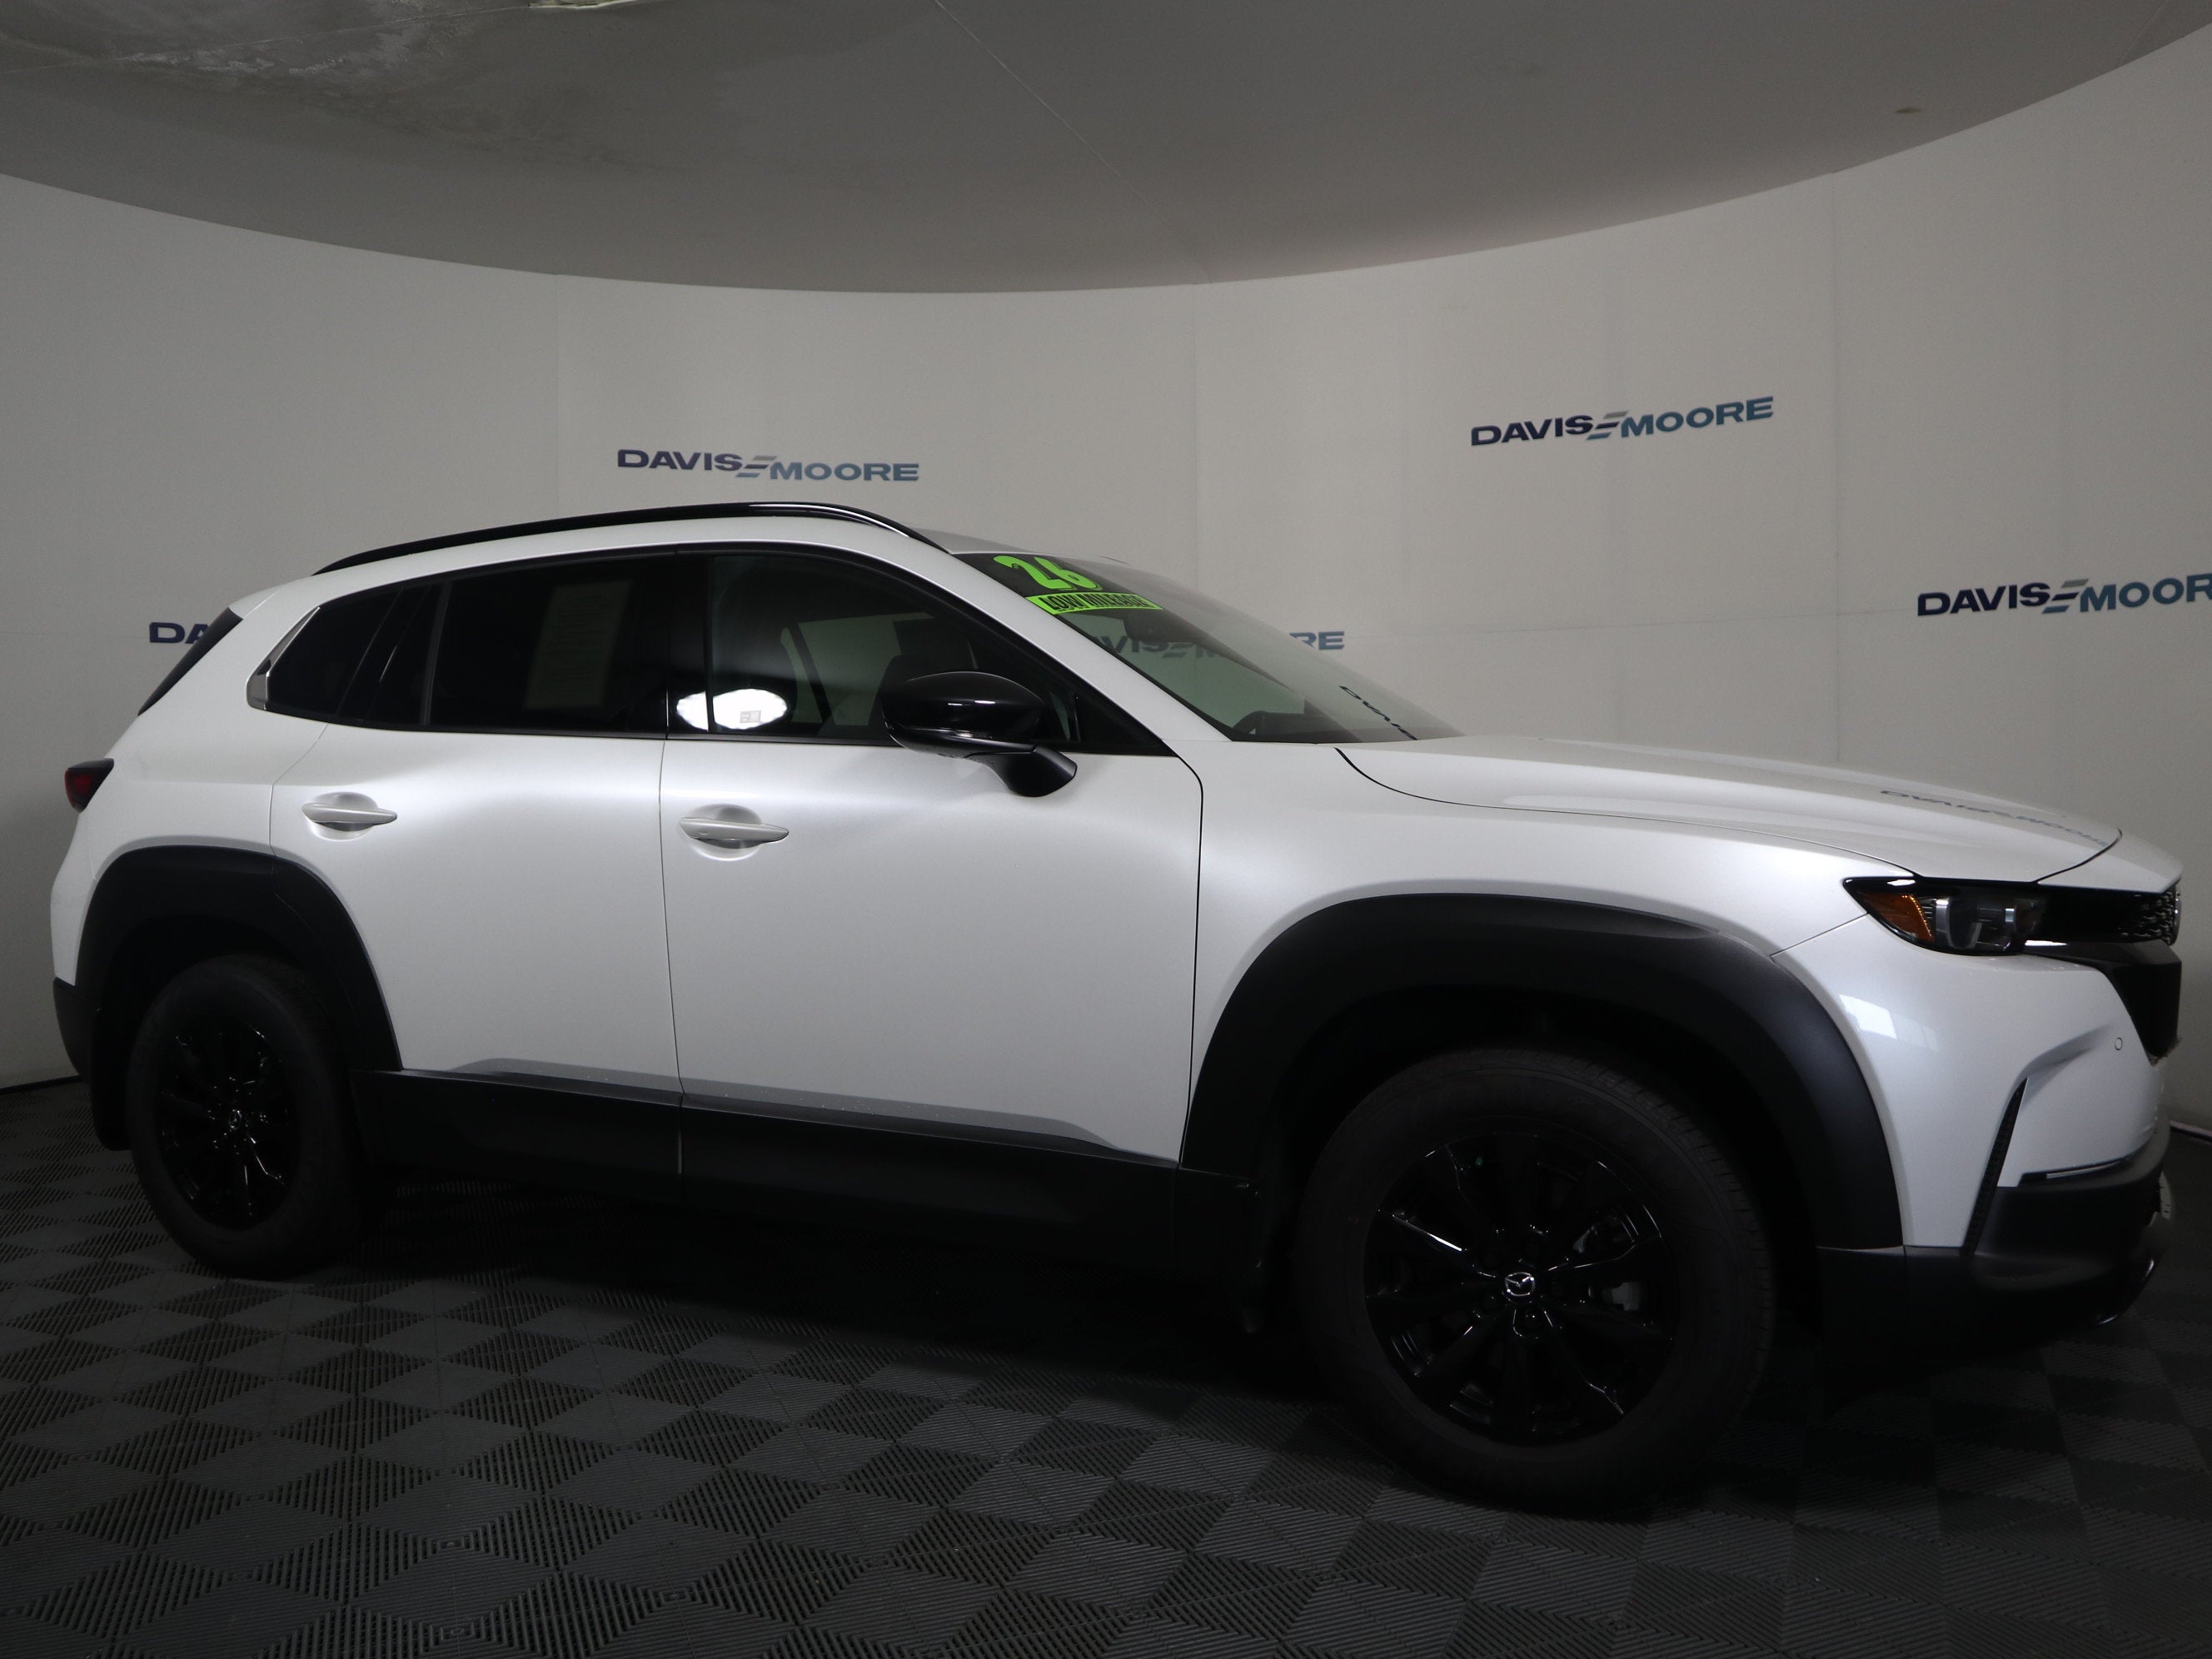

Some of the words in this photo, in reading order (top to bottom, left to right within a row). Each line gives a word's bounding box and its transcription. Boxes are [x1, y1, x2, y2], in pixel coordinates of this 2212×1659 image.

[1471, 415, 1593, 446] DAVIS
[1621, 396, 1773, 438] MOORE
[617, 449, 742, 471] DAVIS
[770, 461, 919, 481] MOORE
[993, 555, 1102, 591] 26
[1039, 594, 1090, 612] LOW
[1082, 593, 1152, 608] MILEAGE
[1917, 582, 2050, 616] DAVIS
[2080, 573, 2212, 612] MOOR
